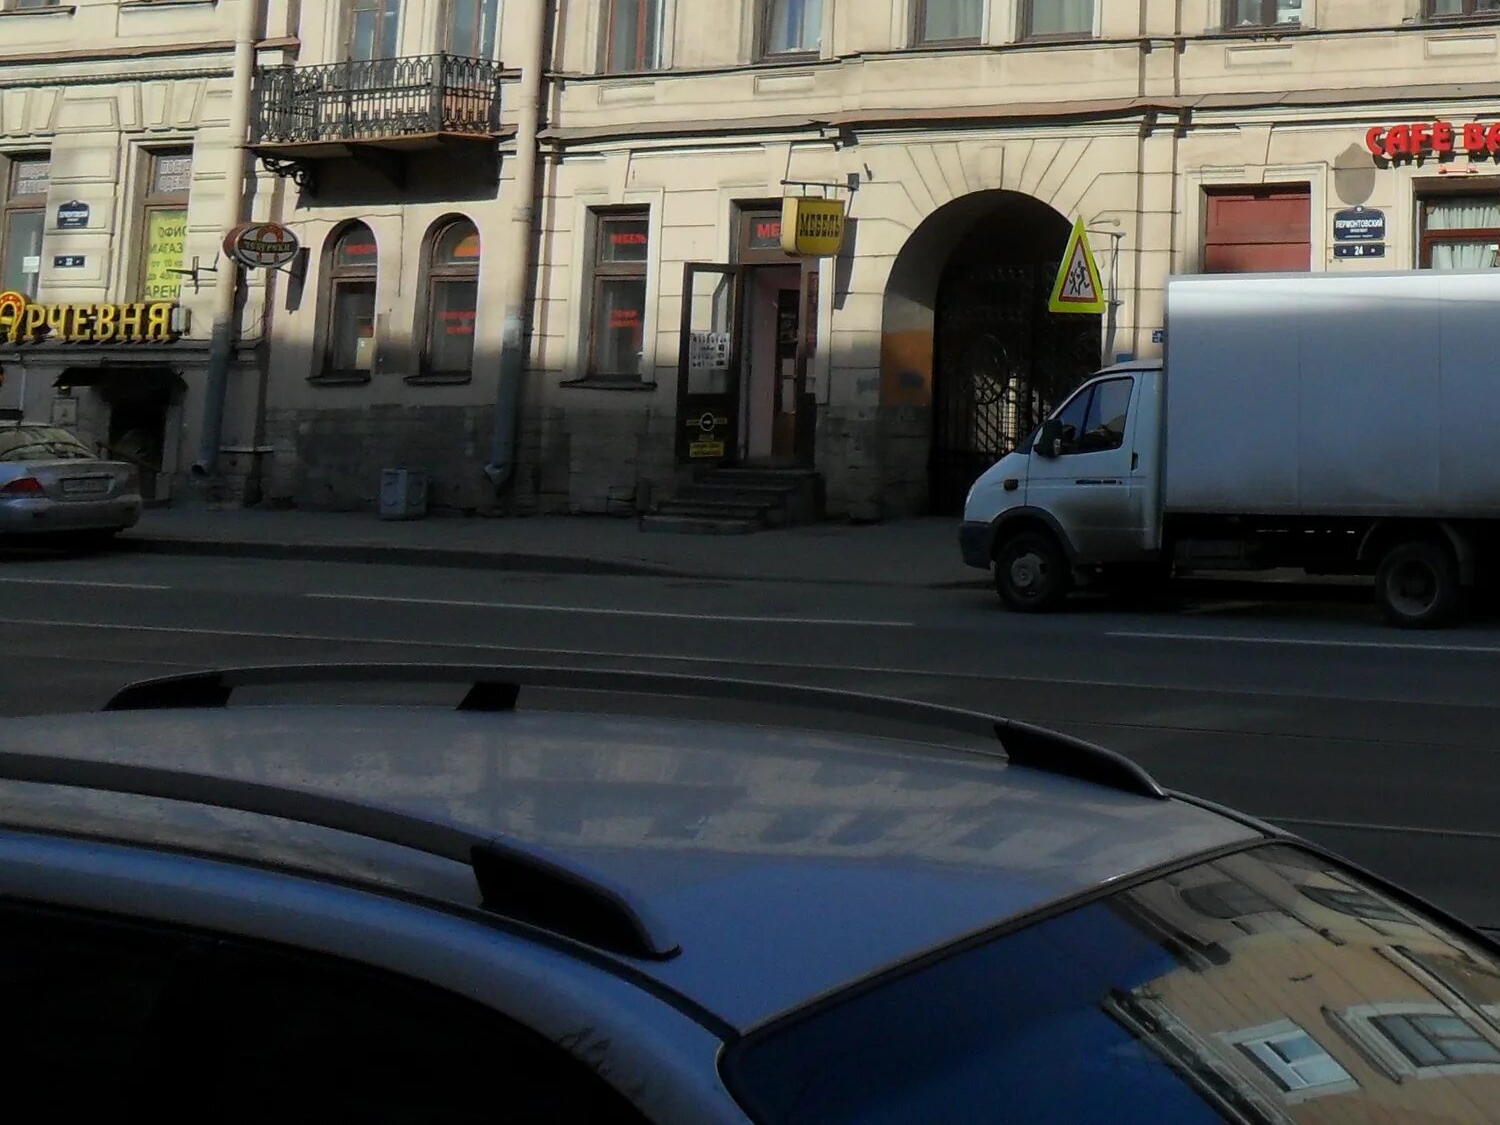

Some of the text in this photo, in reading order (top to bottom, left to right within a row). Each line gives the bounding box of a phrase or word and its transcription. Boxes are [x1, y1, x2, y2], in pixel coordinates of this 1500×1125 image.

[1365, 122, 1453, 160] CAFE
[1354, 245, 1364, 256] 24
[145, 284, 182, 298] АРЕН
